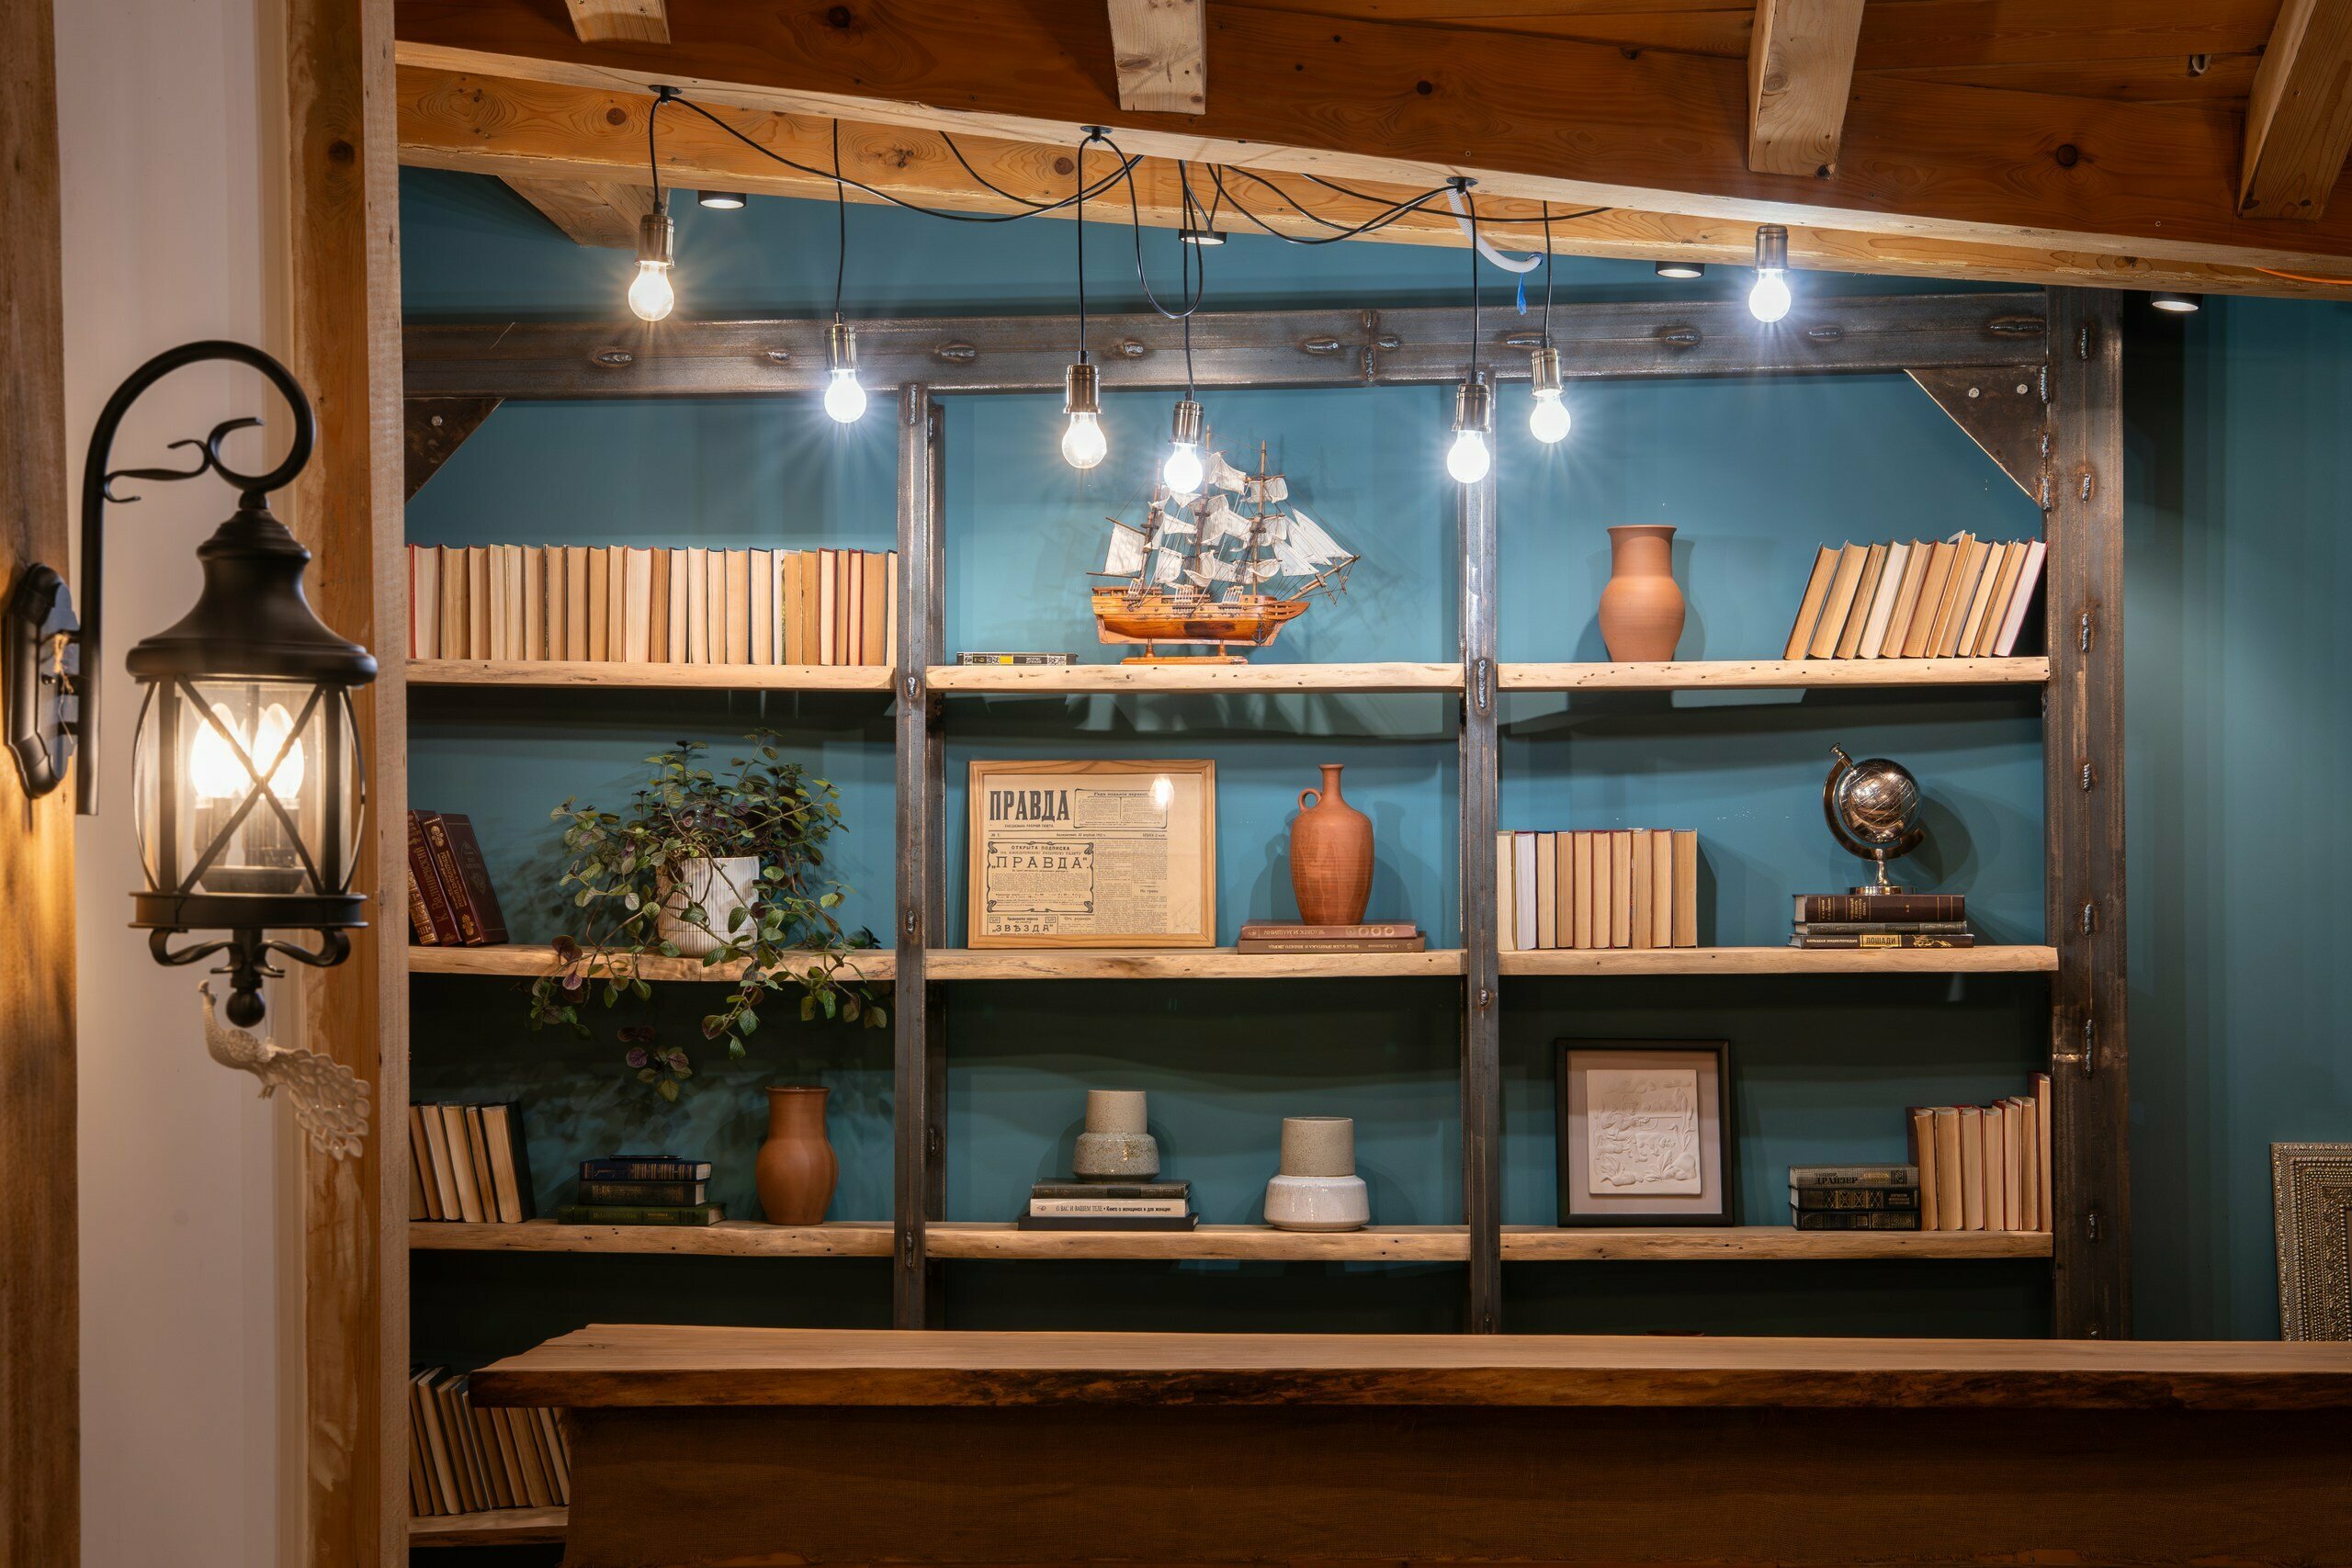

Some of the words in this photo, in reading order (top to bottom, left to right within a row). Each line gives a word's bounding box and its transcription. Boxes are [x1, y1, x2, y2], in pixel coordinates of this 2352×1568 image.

[989, 790, 1070, 822] ПРАВДА
[414, 845, 445, 910] Валишевский
[1866, 937, 1896, 945] ЛОШАДИ
[1815, 1177, 1858, 1185] ДРАЙЗЕР
